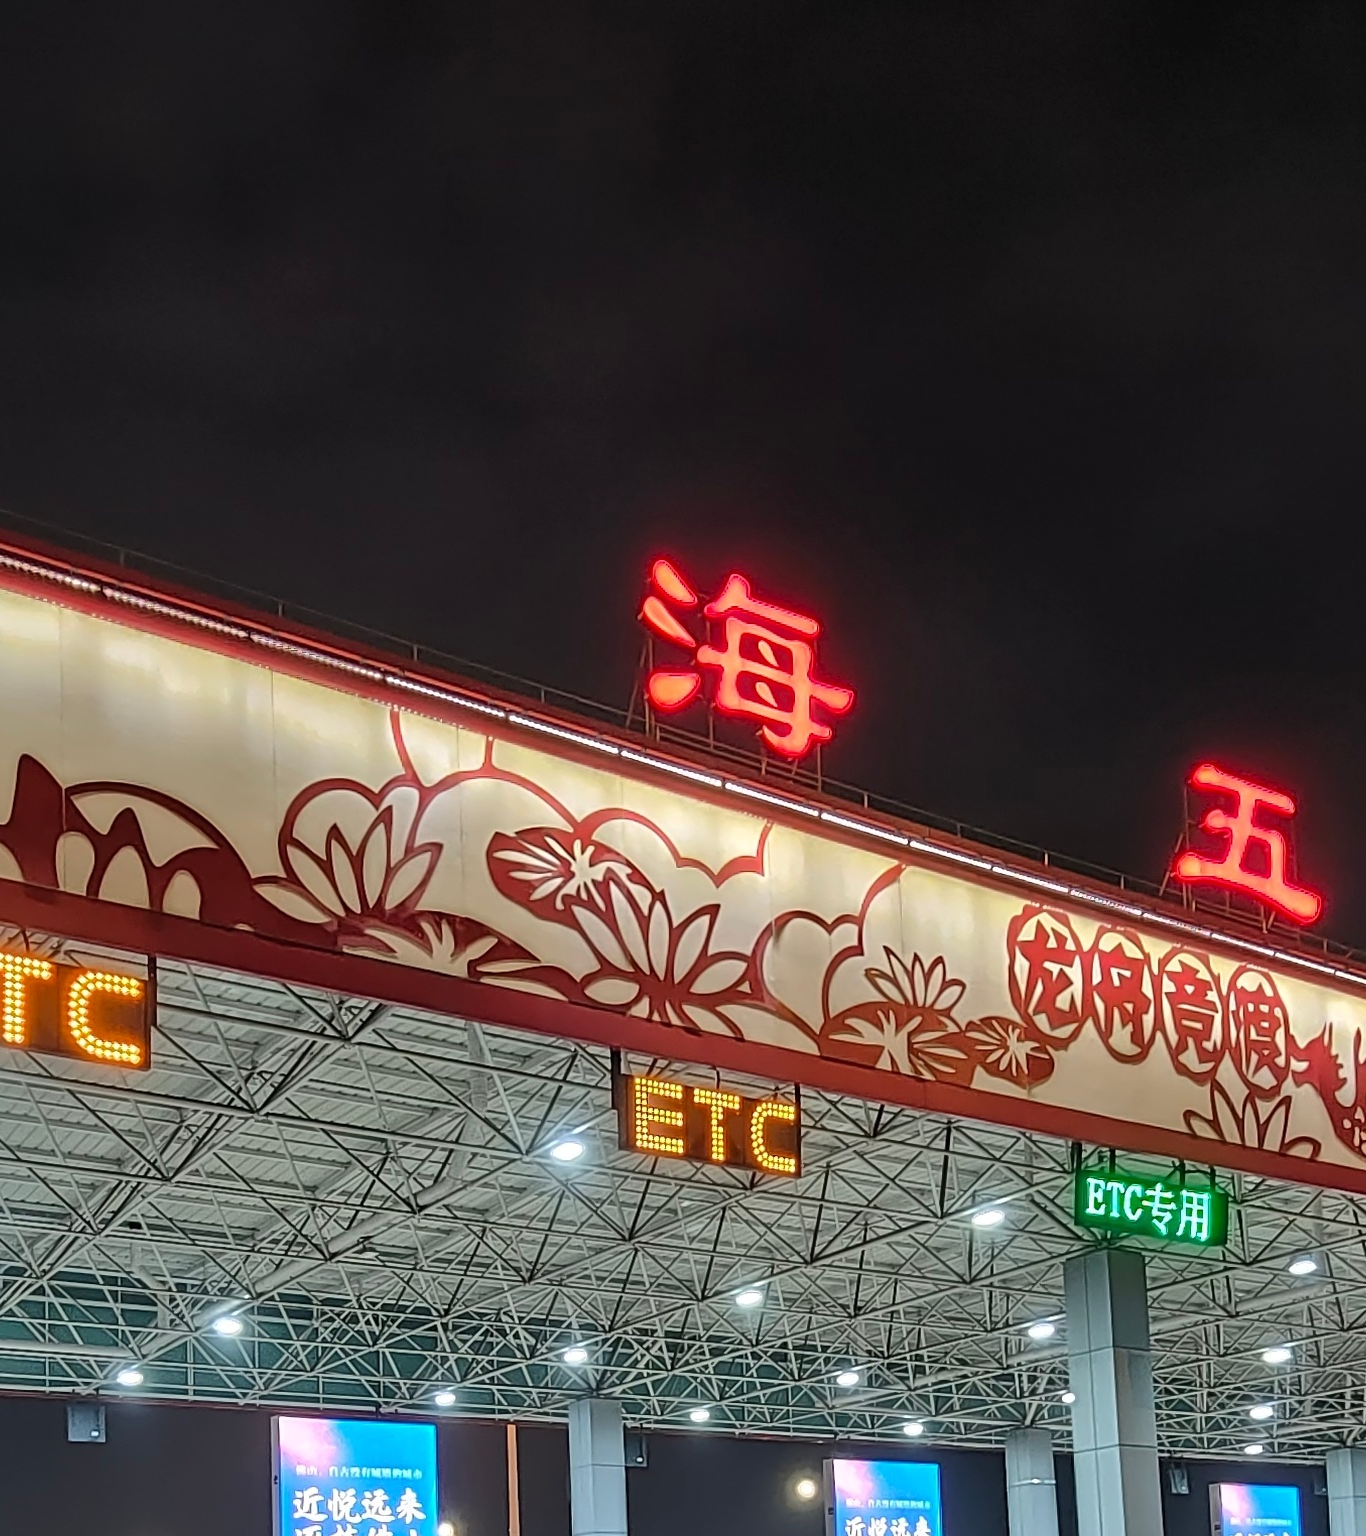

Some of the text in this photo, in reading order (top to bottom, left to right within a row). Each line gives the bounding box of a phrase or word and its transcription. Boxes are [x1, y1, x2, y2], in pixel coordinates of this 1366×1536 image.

[635, 1076, 796, 1173] ETC
[1085, 1177, 1211, 1242] ETC专用
[293, 1486, 427, 1524] 近悦远来
